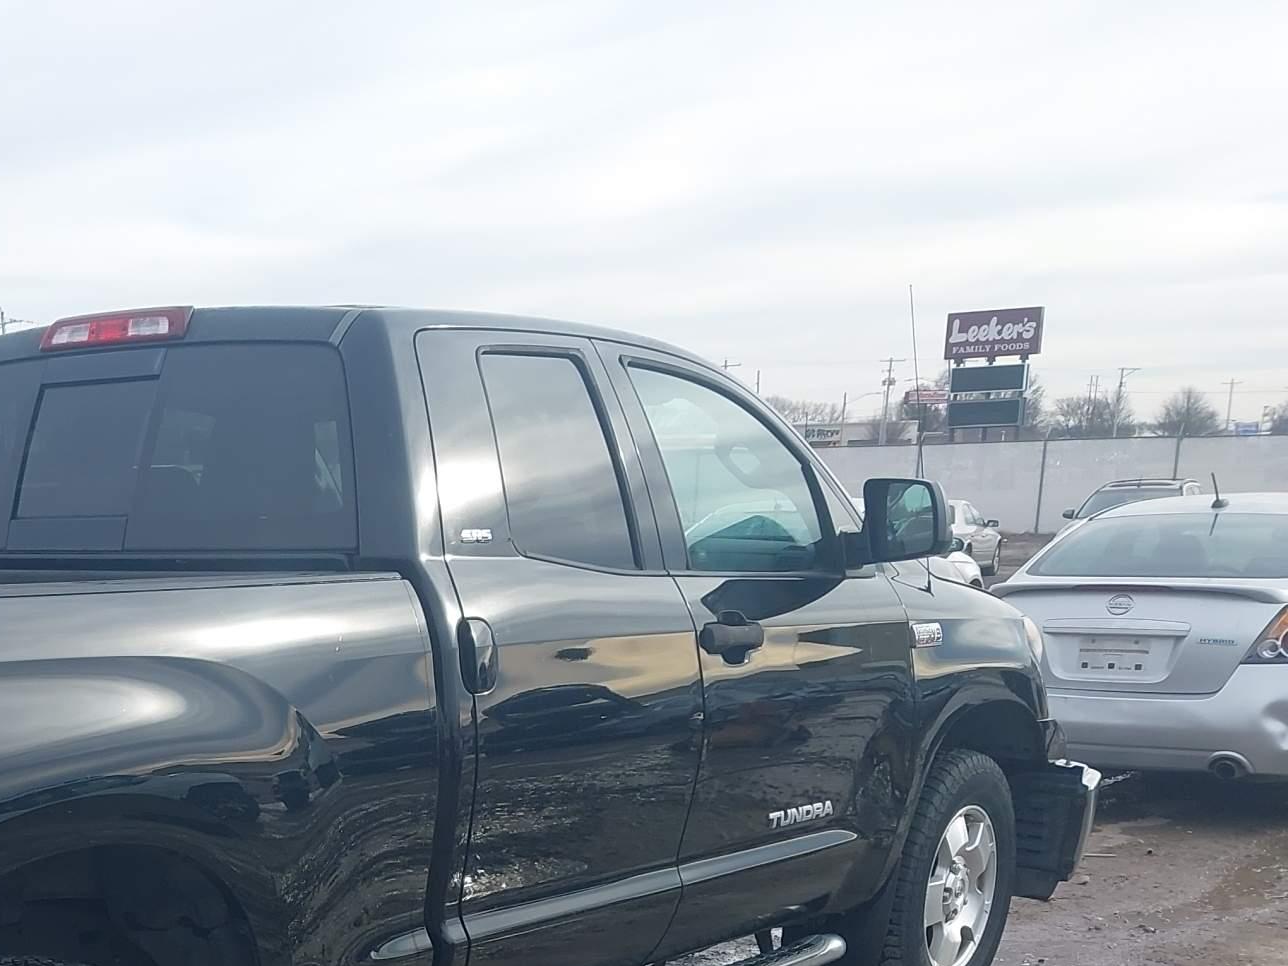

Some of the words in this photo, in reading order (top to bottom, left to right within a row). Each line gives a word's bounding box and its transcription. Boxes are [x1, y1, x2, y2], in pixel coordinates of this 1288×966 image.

[949, 316, 1036, 343] Leeker's
[952, 344, 992, 354] FAMILY
[994, 342, 1030, 351] FOODS
[769, 800, 833, 828] TUNDRA
